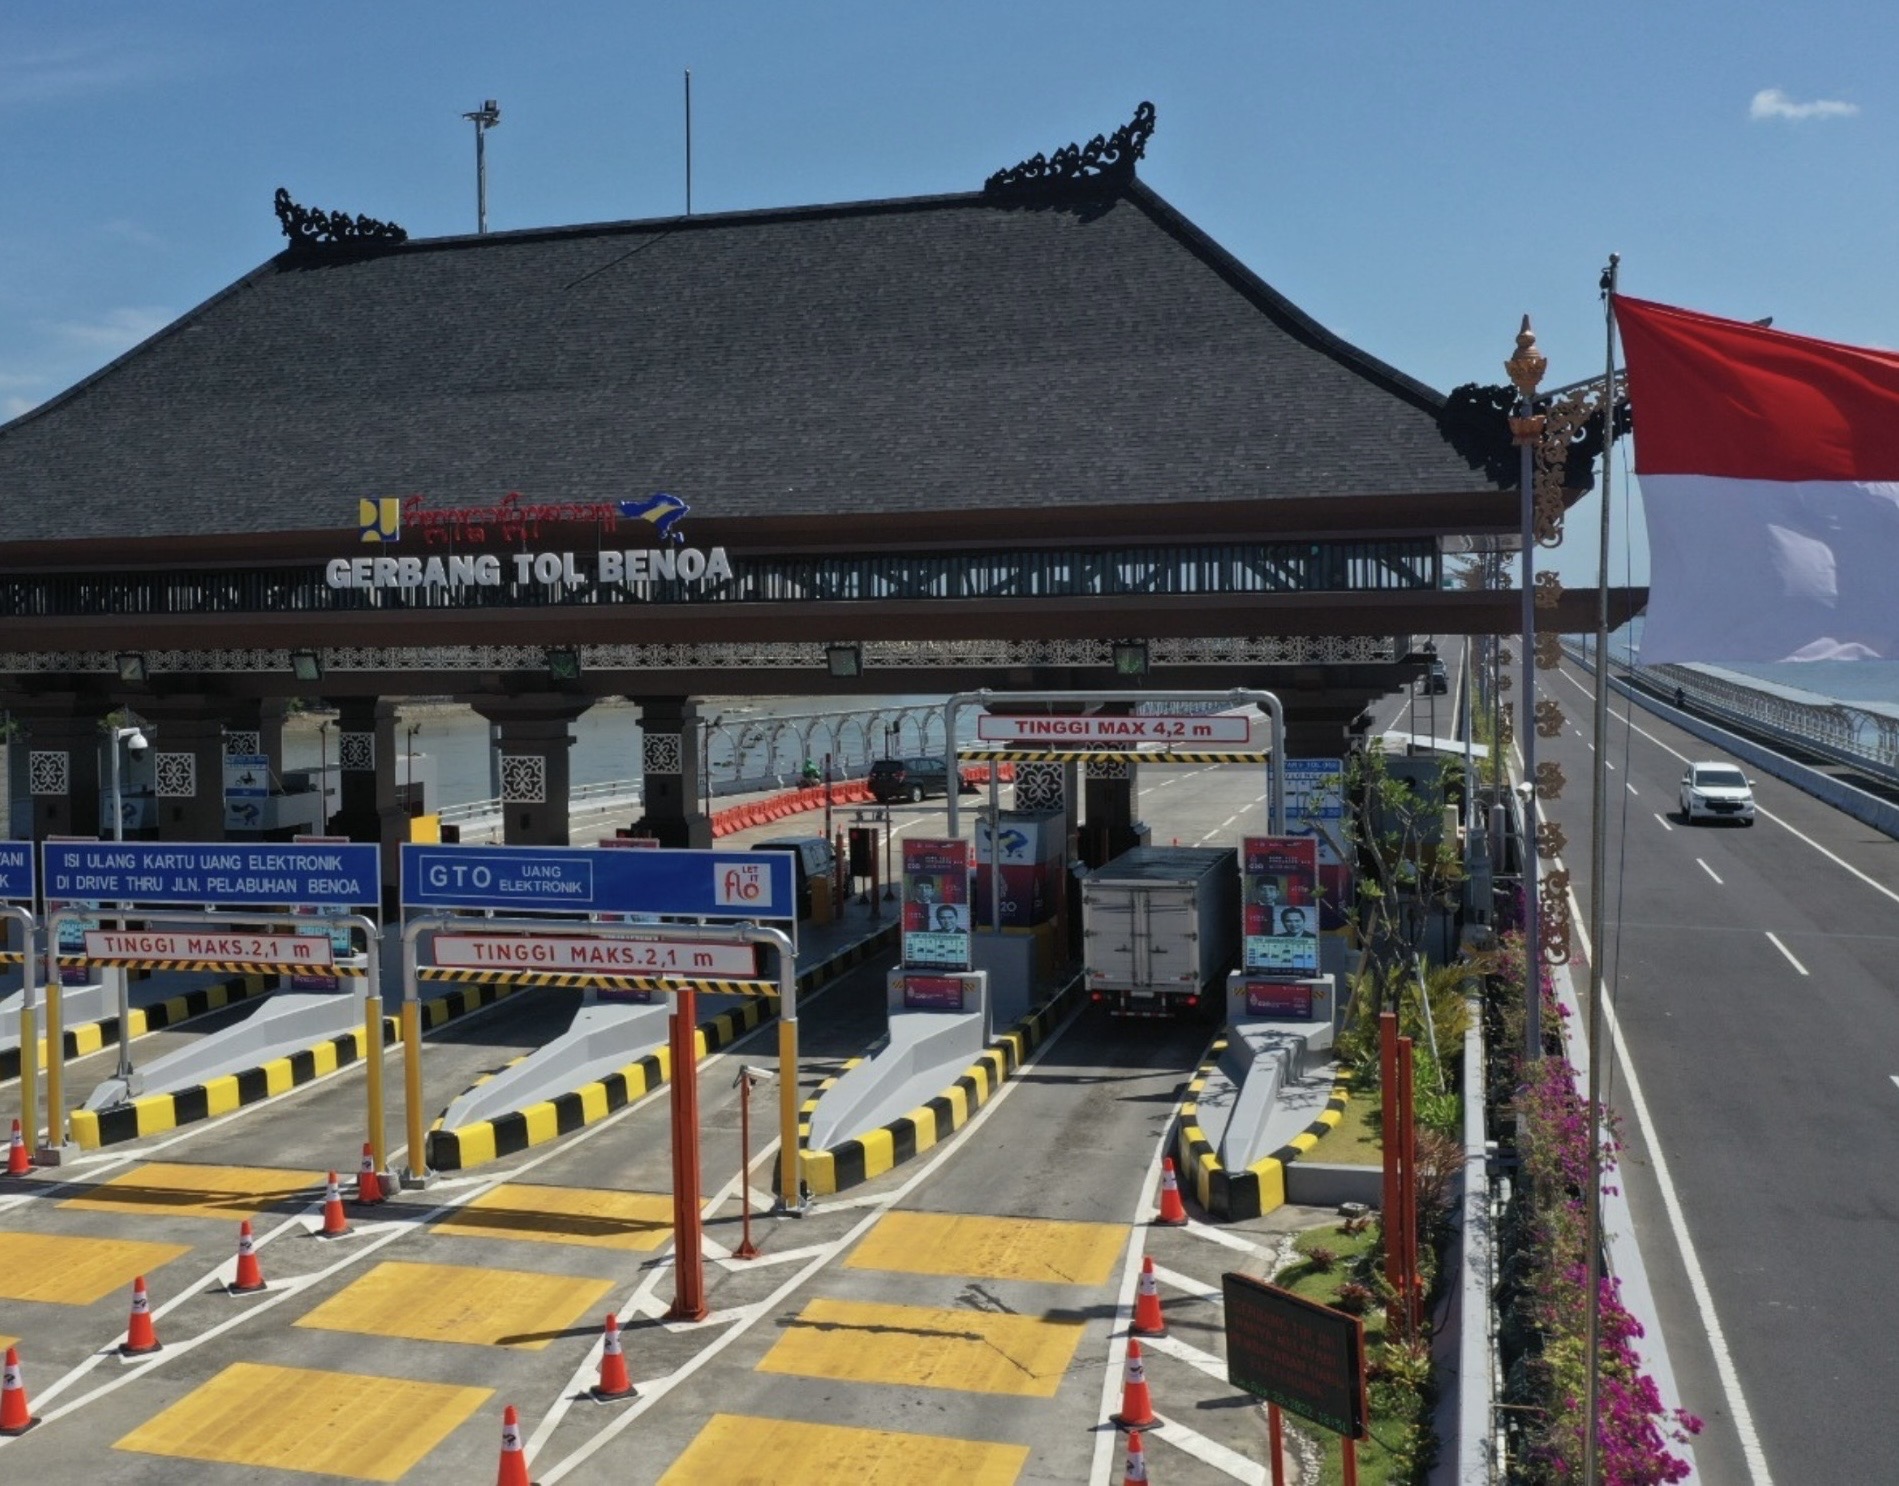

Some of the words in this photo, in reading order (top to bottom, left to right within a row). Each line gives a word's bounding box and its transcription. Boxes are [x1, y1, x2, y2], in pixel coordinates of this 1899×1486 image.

[326, 553, 500, 589] GERBANG
[512, 551, 586, 585] TOL
[599, 546, 733, 582] BENOA
[1015, 720, 1089, 735] TINGGI
[1098, 721, 1146, 736] MAX
[1153, 721, 1185, 738] 4,2
[1192, 724, 1212, 736] m
[64, 853, 79, 868] ISI
[87, 853, 136, 869] ULANG
[144, 854, 194, 869] KARTU
[200, 855, 241, 870] UANG
[250, 855, 342, 871] ELEKTRONIK
[429, 865, 491, 889] GTO
[522, 865, 561, 878] UANG
[750, 874, 759, 882] IT
[56, 875, 69, 890] DI
[76, 876, 118, 890] DRIVE
[126, 876, 162, 891] THRU
[171, 877, 201, 892] JLN.
[207, 878, 297, 893] PELABUHAN
[308, 879, 360, 894] BENOA
[499, 879, 582, 894] ELEKTRONIK
[104, 936, 175, 953] TINGGI
[294, 944, 310, 958] m
[473, 942, 555, 962] TINGGI
[694, 952, 714, 967] m
